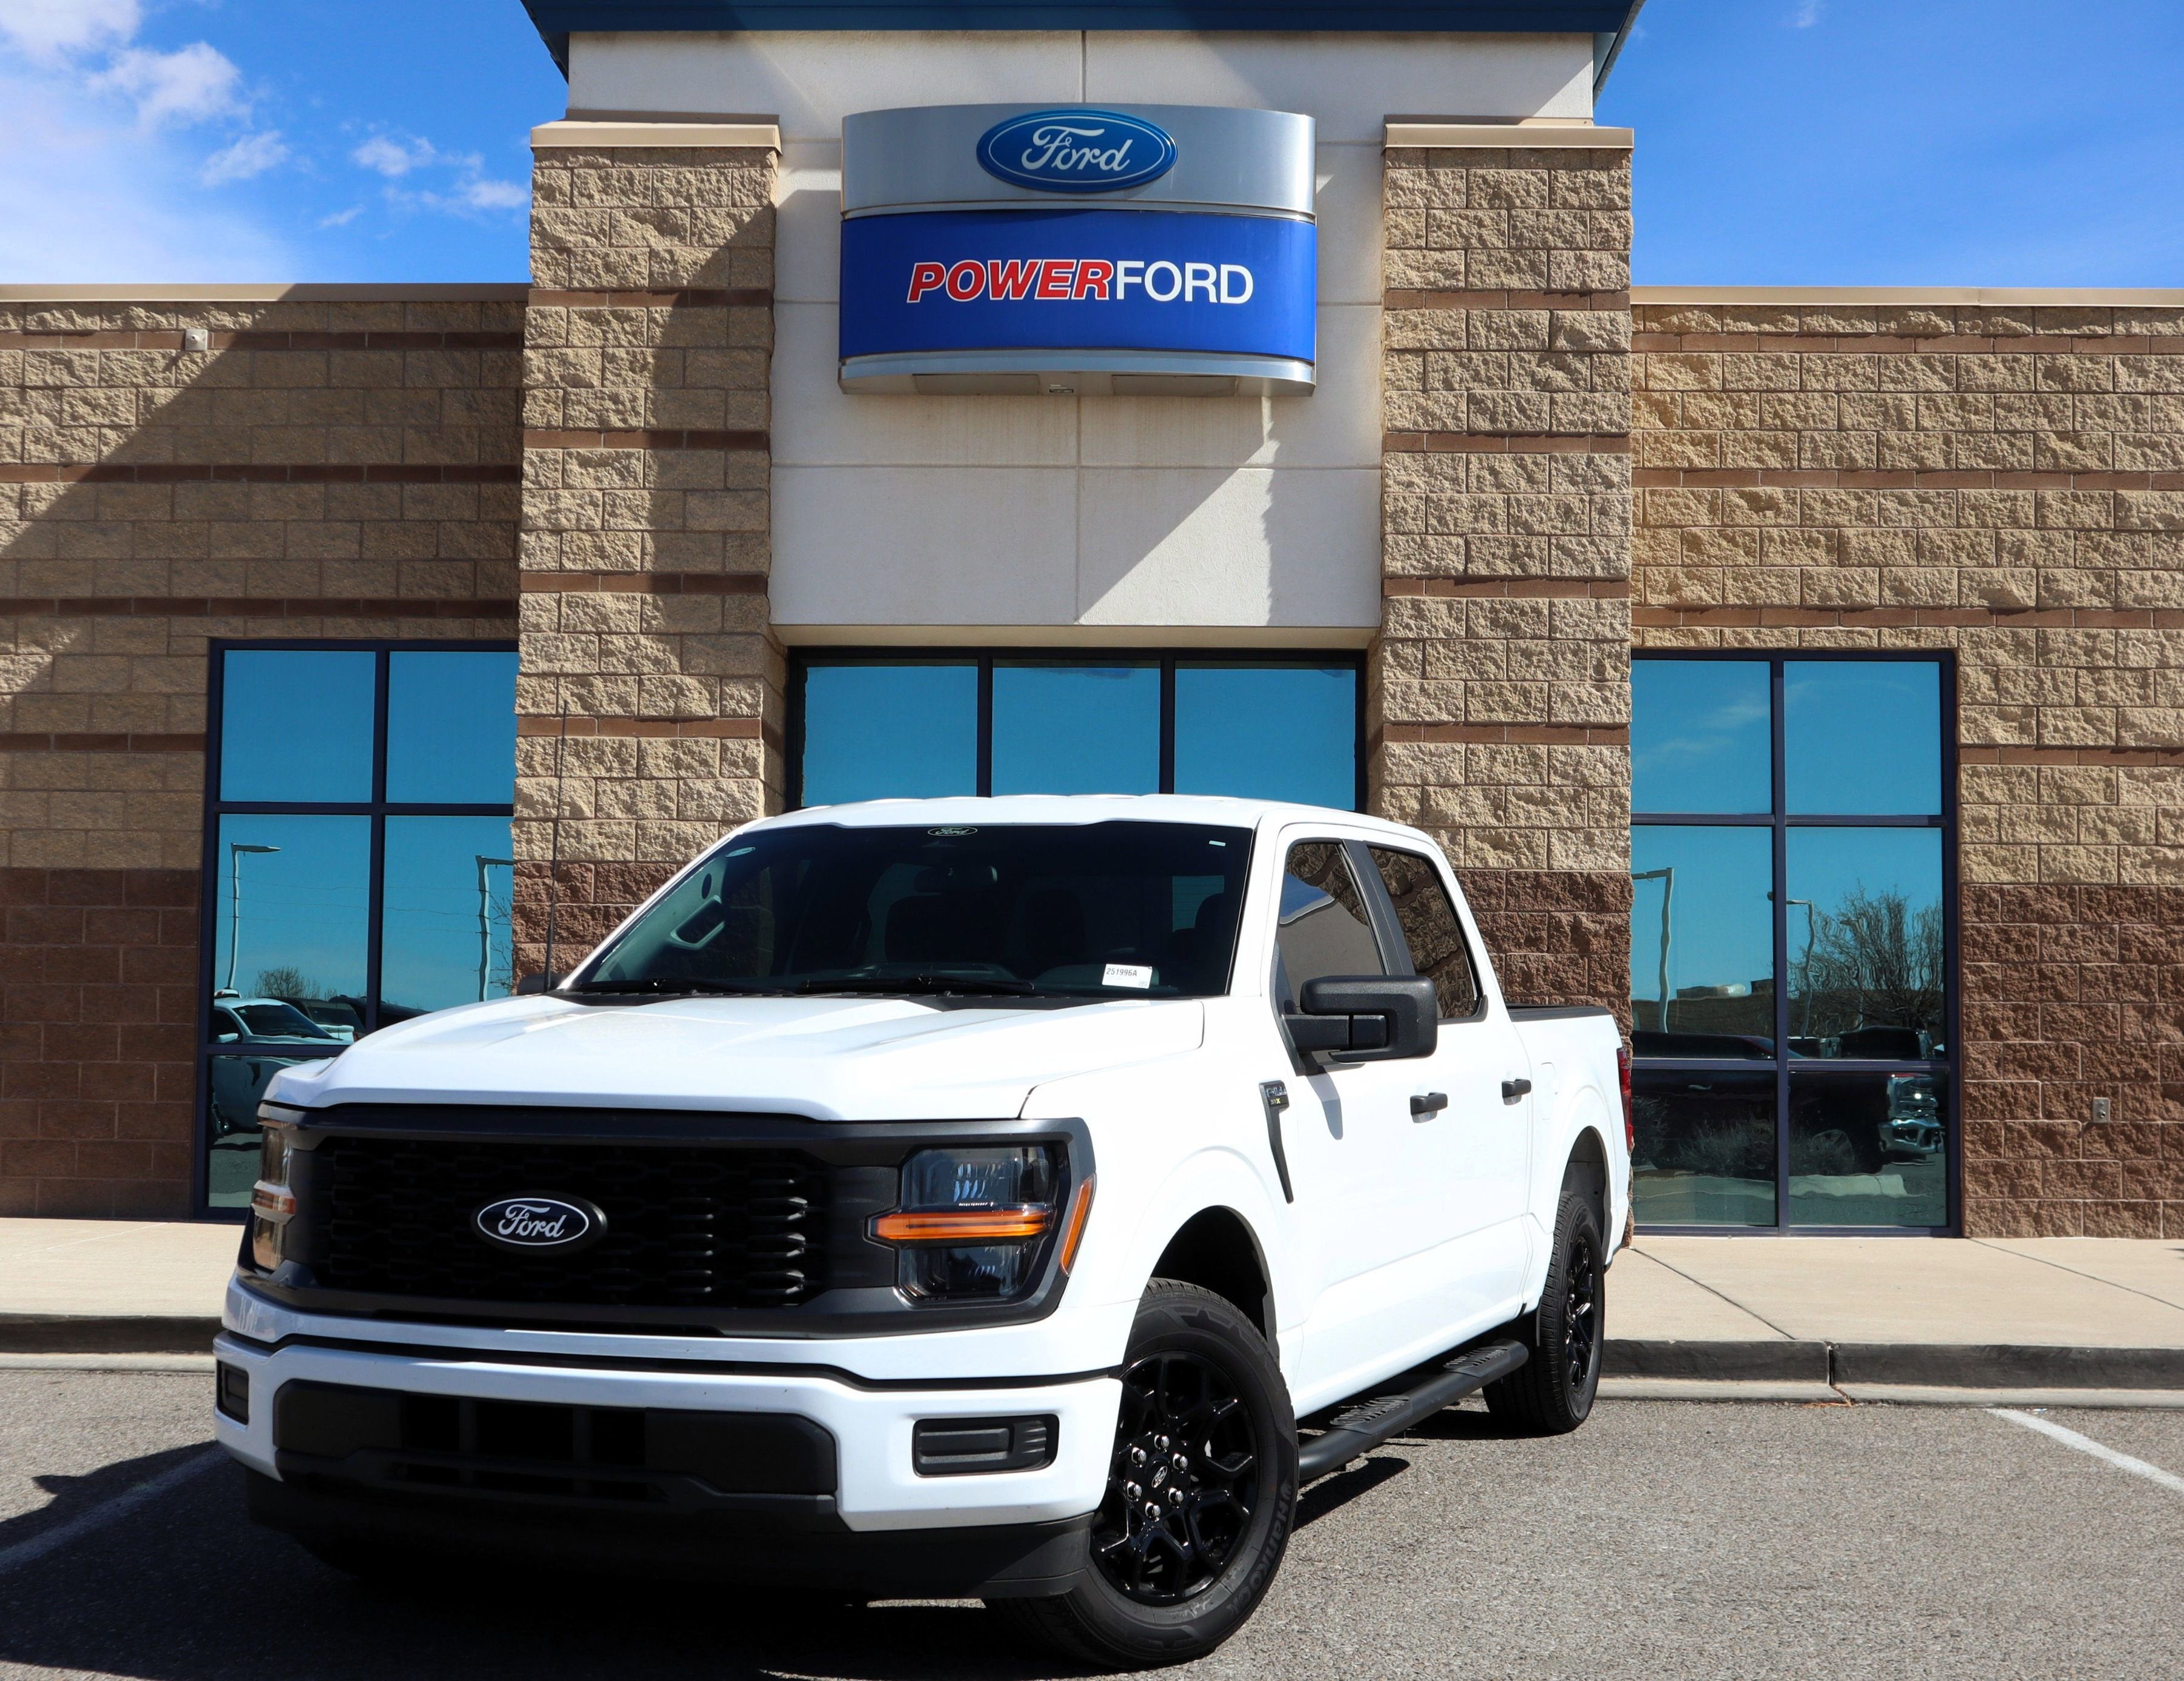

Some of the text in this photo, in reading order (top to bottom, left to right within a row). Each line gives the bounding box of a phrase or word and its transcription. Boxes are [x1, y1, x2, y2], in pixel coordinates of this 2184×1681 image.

[1021, 125, 1133, 171] Ford
[1106, 968, 1137, 977] 251996A
[498, 1204, 567, 1237] Ford
